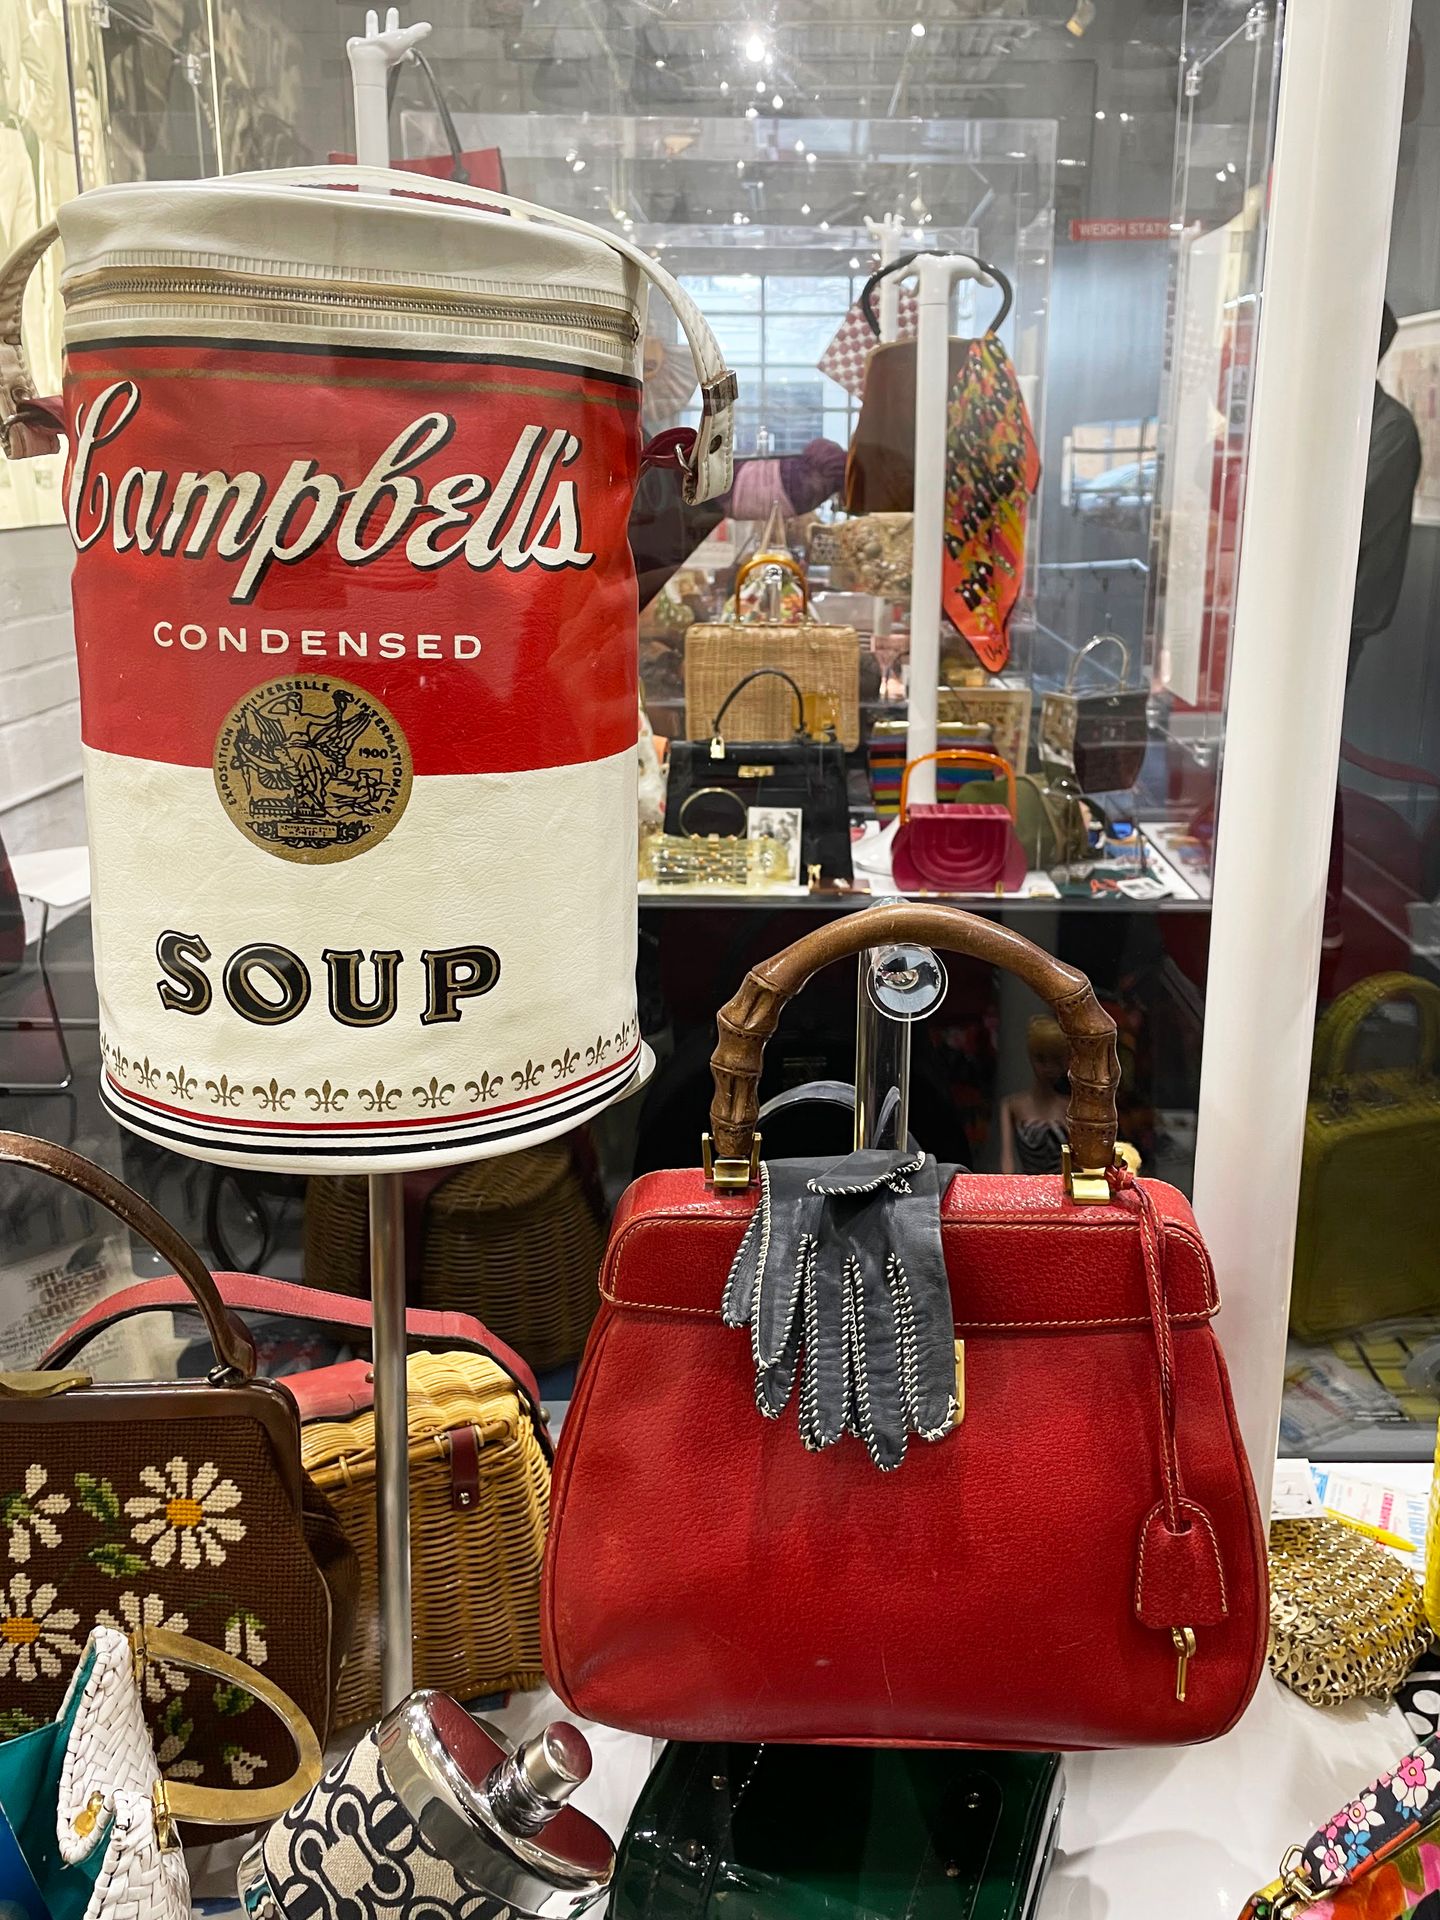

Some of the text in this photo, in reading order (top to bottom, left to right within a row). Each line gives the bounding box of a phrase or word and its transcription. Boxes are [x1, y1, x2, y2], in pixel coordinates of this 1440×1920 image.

[1079, 222, 1127, 236] WEIGH
[68, 380, 595, 605] Campbell's
[152, 620, 483, 661] CONDENSED
[218, 680, 403, 815] EXPOSITION UNIVERSELLE INTERNATIONALE
[358, 747, 389, 760] 1900
[156, 929, 502, 1029] SOUP
